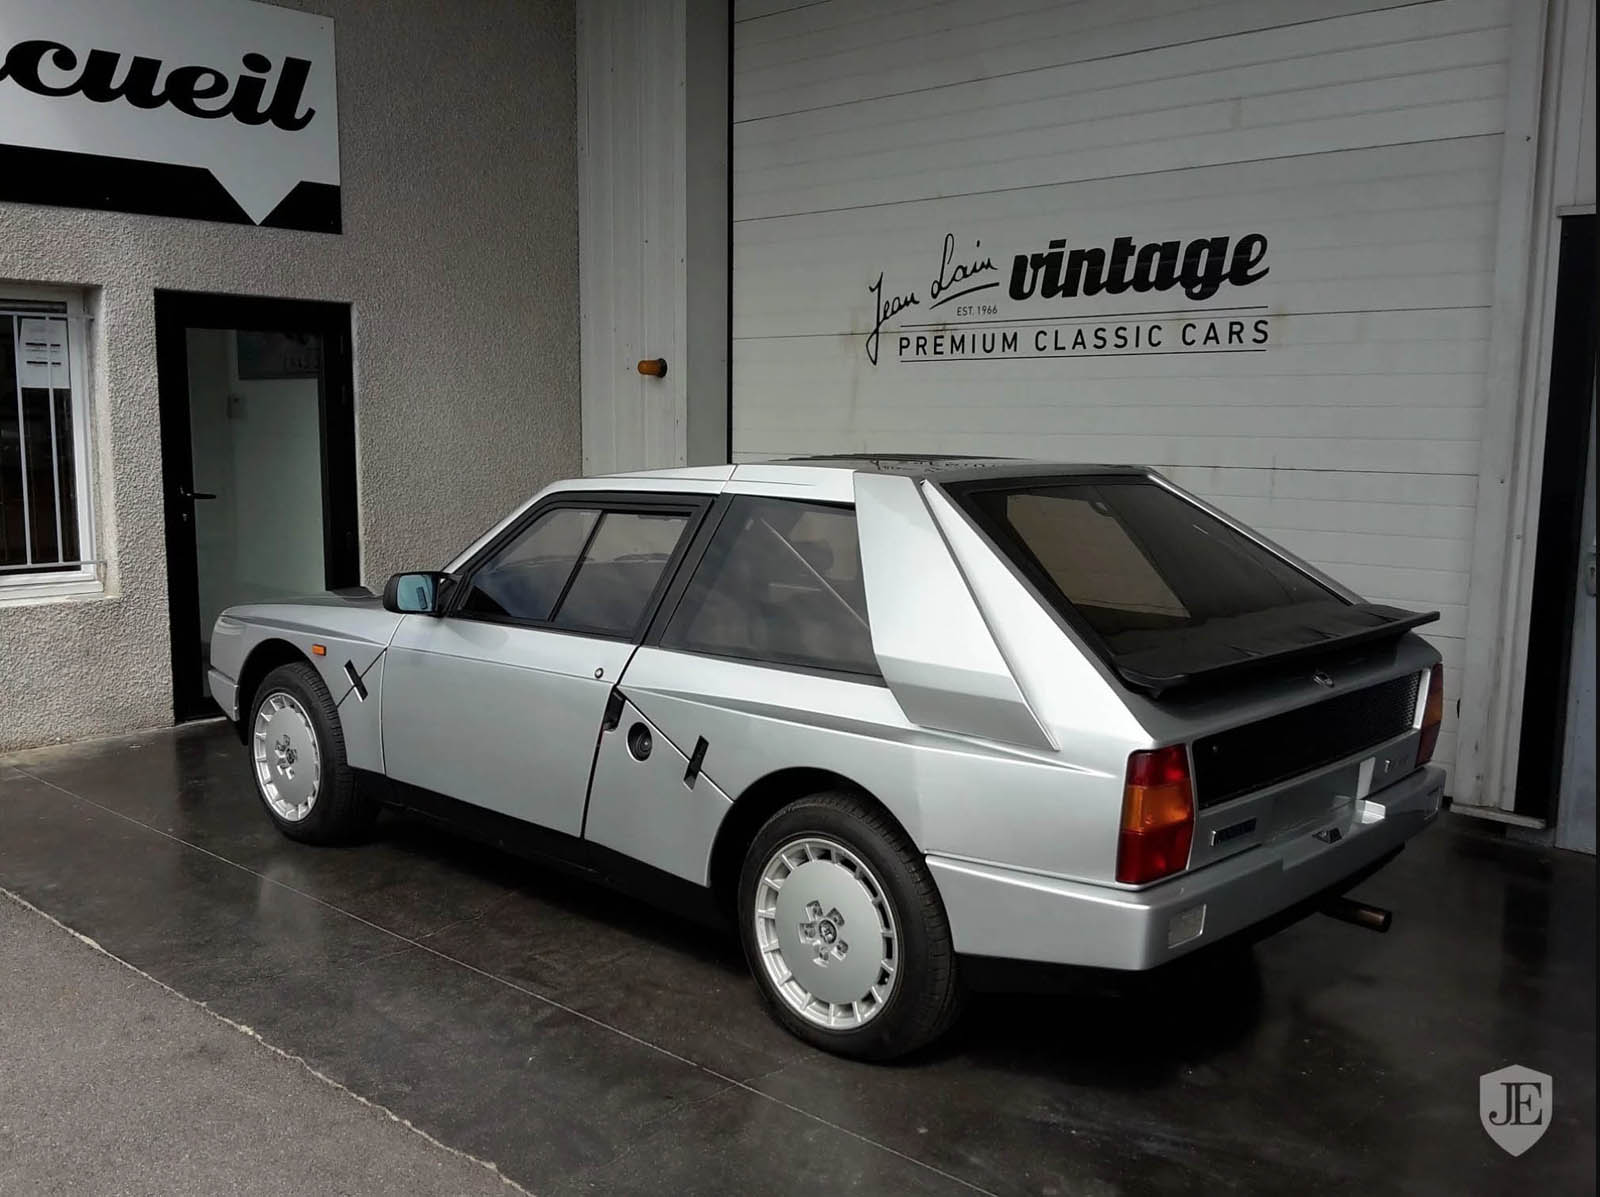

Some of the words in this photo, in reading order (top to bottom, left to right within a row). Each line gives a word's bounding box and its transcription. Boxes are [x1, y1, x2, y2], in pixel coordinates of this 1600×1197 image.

[0, 39, 316, 132] cueil
[866, 271, 920, 366] Jean
[931, 233, 998, 299] Lain
[1008, 233, 1270, 301] vintage
[977, 304, 998, 316] 1966
[899, 332, 1018, 357] PREMIUM
[1034, 320, 1163, 352] CLASSIC
[1181, 319, 1269, 347] CARS
